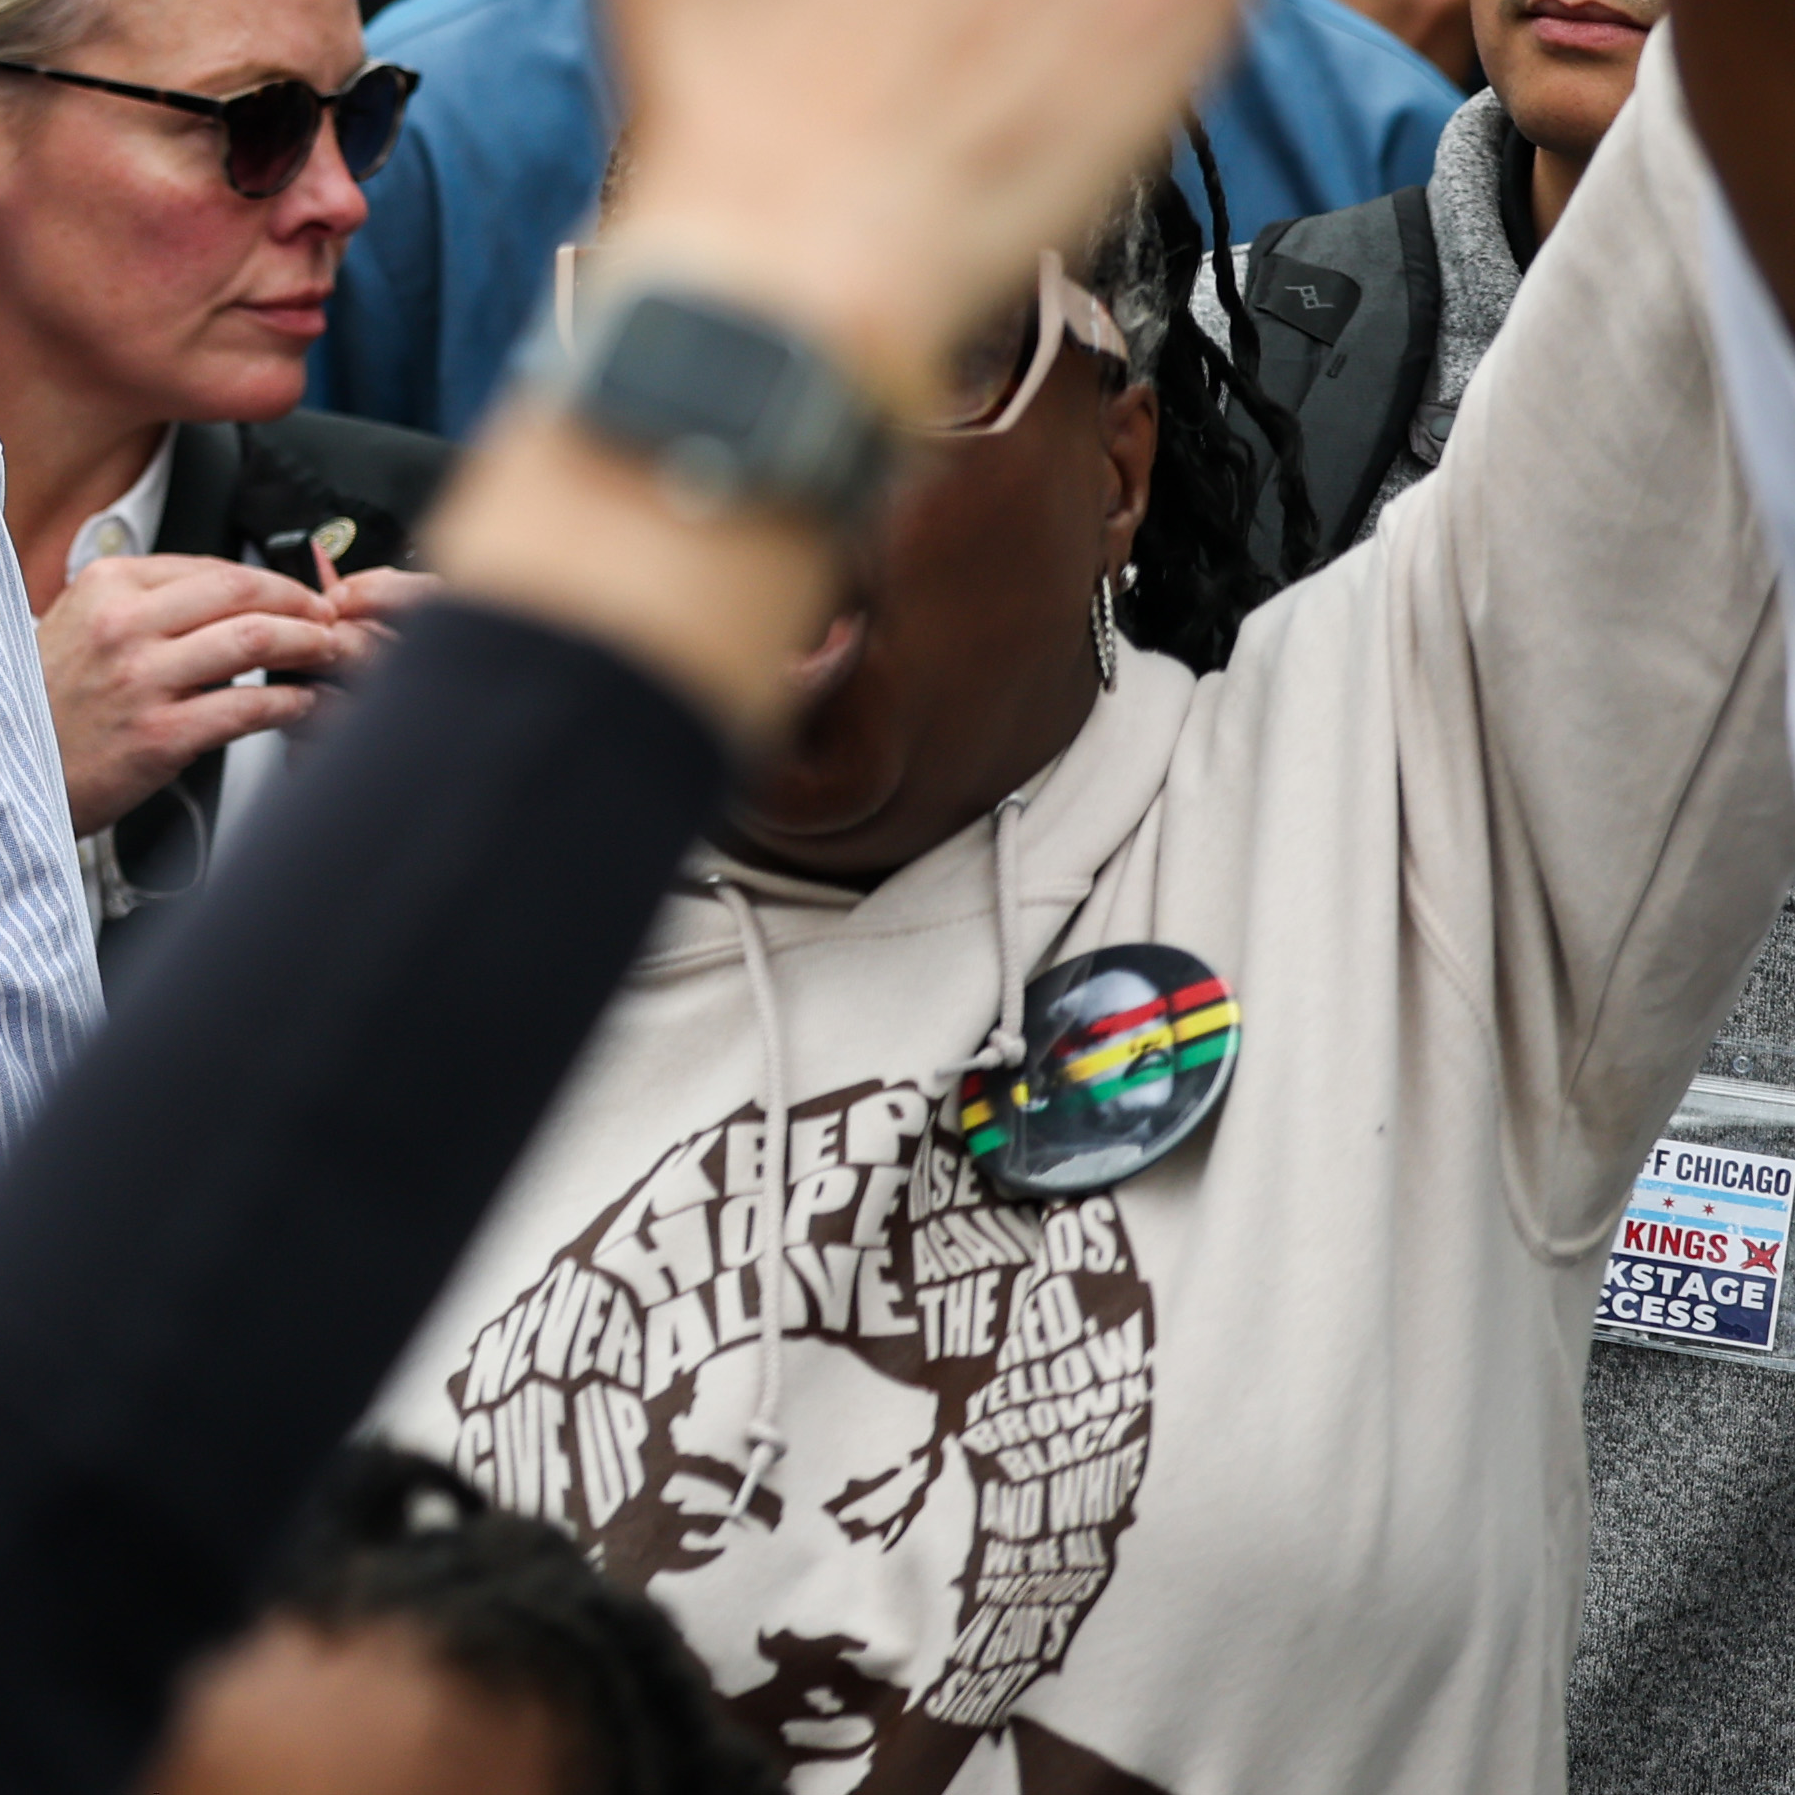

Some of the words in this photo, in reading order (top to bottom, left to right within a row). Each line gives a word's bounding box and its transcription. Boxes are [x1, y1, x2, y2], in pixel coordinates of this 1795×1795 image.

[593, 1086, 929, 1254] KEEP
[1676, 1152, 1793, 1197] CHICAGO
[591, 1164, 911, 1308] HOPE
[1624, 1220, 1729, 1264] KINGS
[461, 1256, 644, 1411] NEVER
[641, 1242, 921, 1403] ALIVE
[915, 1270, 1001, 1362] THE
[456, 1378, 579, 1542] GIVE
[575, 1378, 650, 1531] UP
[980, 1478, 1045, 1540] AND
[1047, 1434, 1147, 1534] WHITE
[995, 1406, 1145, 1483] BLACK
